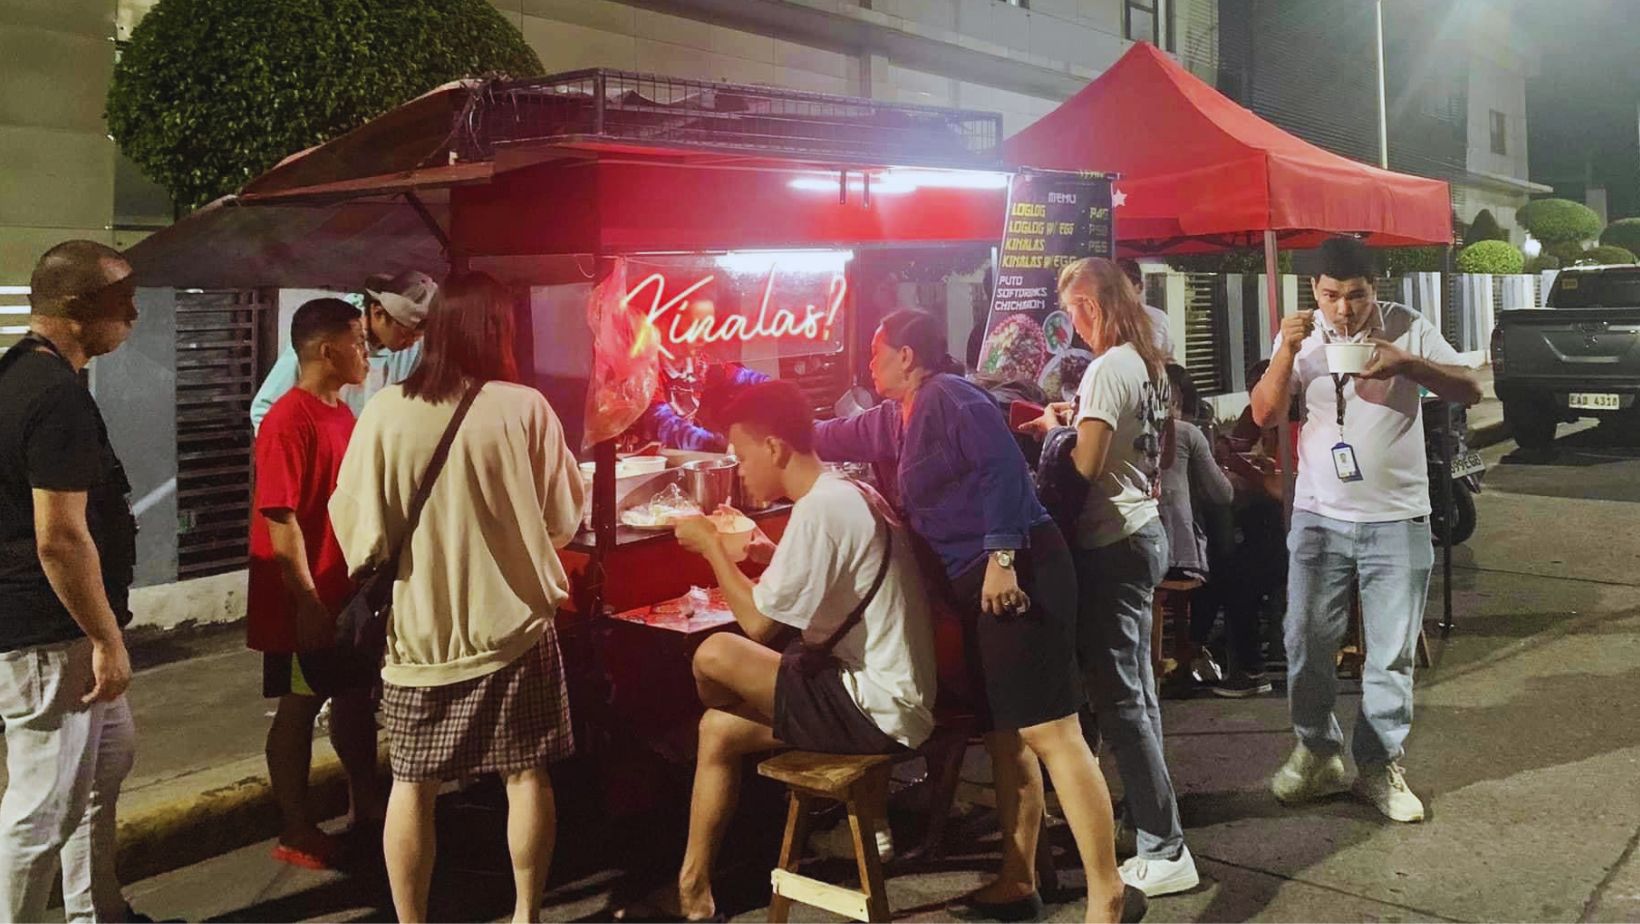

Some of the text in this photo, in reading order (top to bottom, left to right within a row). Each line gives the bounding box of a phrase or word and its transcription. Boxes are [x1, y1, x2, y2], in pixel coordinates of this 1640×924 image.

[1012, 203, 1046, 217] LOGLOG
[1008, 220, 1045, 235] LOGLOG
[1005, 238, 1046, 251] KINALAS
[1002, 255, 1042, 268] KINALAS
[999, 275, 1023, 286] PUTO
[996, 287, 1047, 299] SOFTDRINKS
[619, 262, 847, 360] Kinalas!
